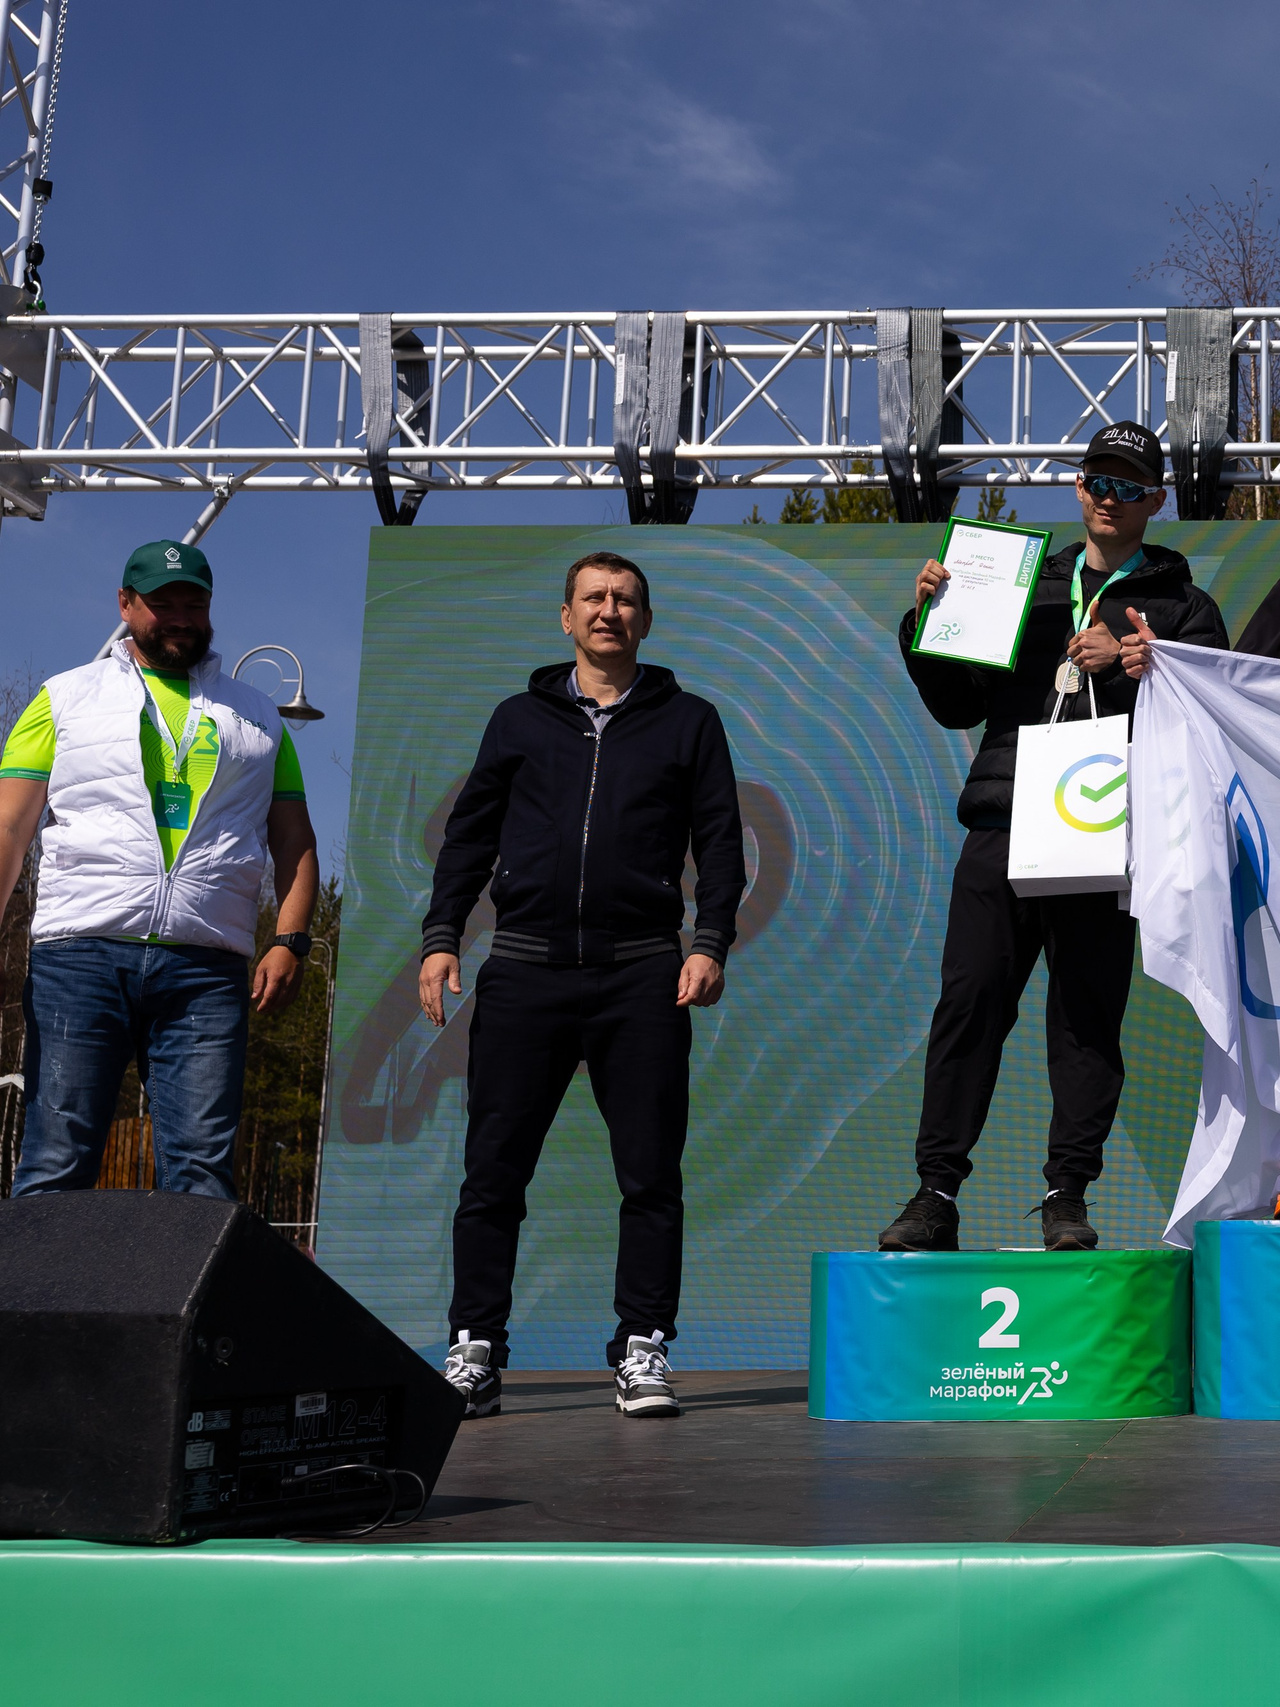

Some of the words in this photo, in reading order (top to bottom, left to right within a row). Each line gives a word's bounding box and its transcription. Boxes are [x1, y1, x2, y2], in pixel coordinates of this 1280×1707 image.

[965, 531, 983, 539] СБЕР
[975, 554, 995, 562] МЕСТО
[1018, 540, 1038, 585] ДИПЛОМ
[187, 719, 196, 736] СБЕР
[244, 717, 268, 731] СБЕР
[978, 1286, 1020, 1348] 2
[941, 1362, 1025, 1380] зелёный
[930, 1381, 1017, 1401] марафон
[187, 1411, 204, 1432] dB
[242, 1404, 287, 1425] STAGE
[330, 1439, 355, 1448] ACTIVE
[357, 1435, 388, 1445] SPEAKER
[239, 1449, 258, 1457] HIGH
[258, 1445, 301, 1455] EFFICIENCY
